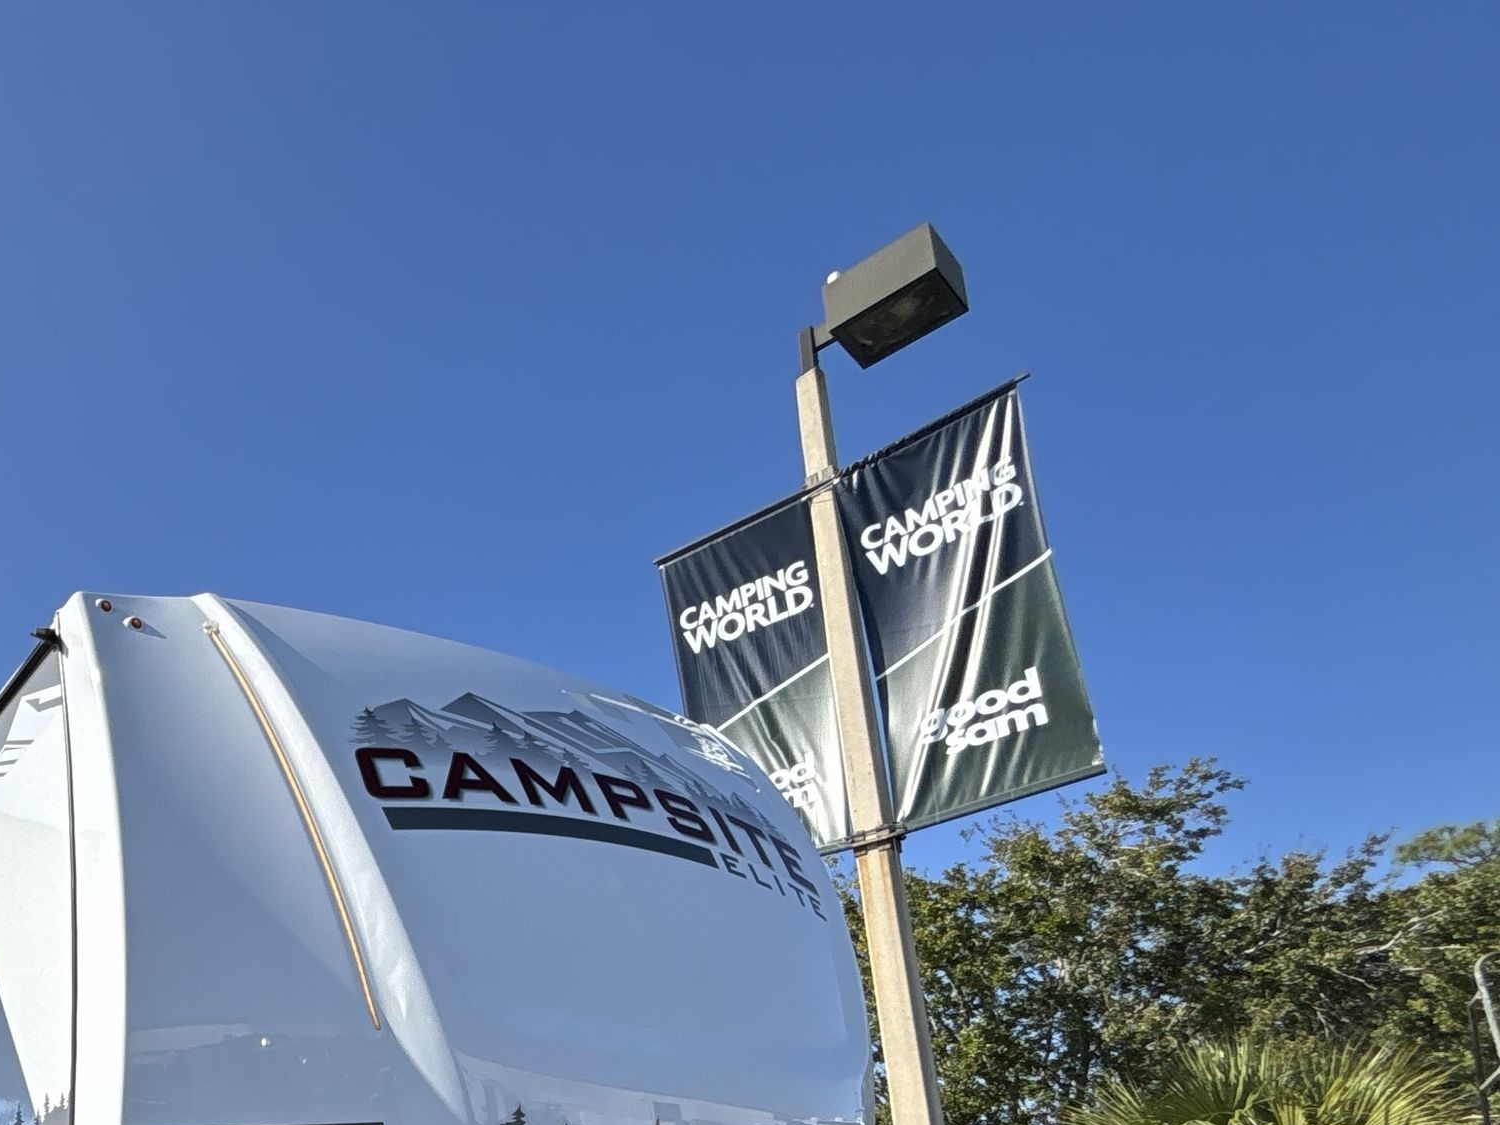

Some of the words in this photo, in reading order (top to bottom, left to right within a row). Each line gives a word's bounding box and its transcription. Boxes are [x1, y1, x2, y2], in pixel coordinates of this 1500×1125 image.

[861, 456, 1017, 549] CAMPING
[865, 483, 1022, 575] WORLD
[680, 561, 809, 630] CAMPING
[683, 586, 813, 653] WORLD
[920, 666, 1042, 744] good
[945, 703, 1048, 754] sam
[769, 751, 815, 791] od
[355, 747, 819, 897] CAMPSITE
[718, 854, 827, 921] ELITE
